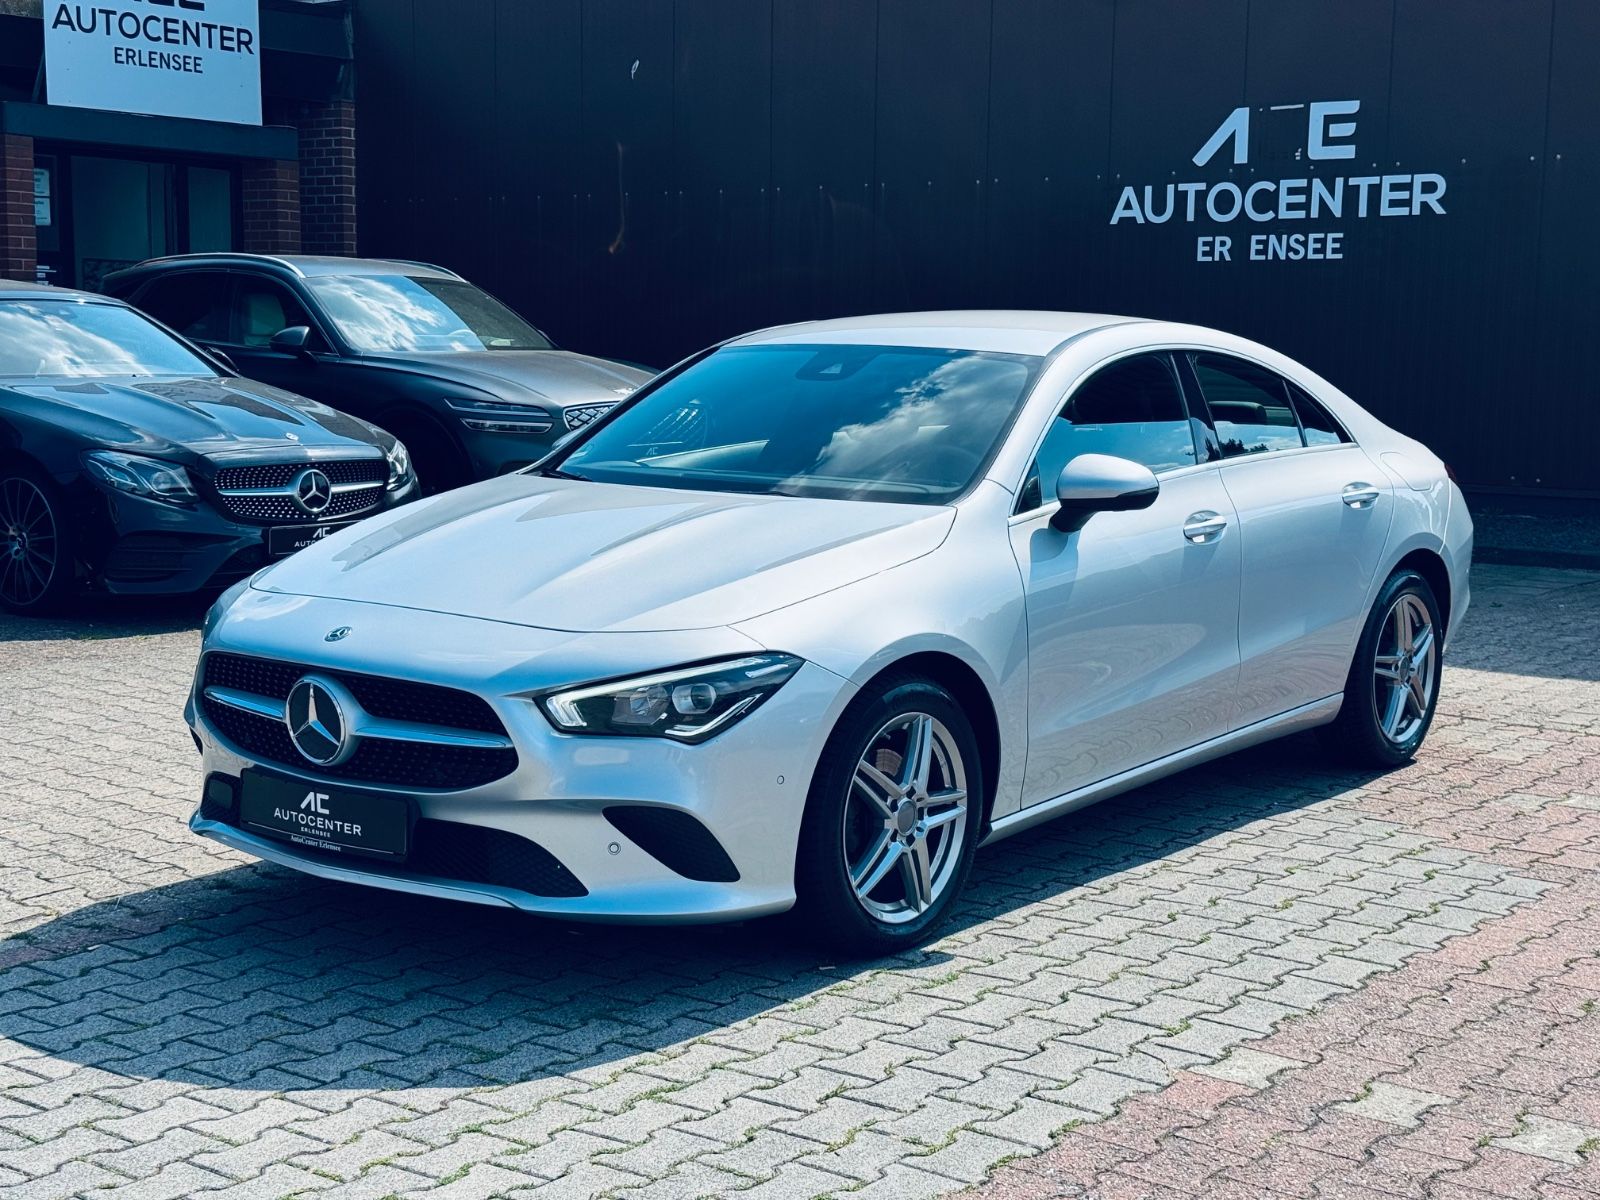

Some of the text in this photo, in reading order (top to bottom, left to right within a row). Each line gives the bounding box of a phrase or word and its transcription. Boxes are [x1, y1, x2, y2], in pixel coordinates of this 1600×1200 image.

[51, 3, 254, 55] AUTOCENTER
[114, 46, 204, 74] ERLENSEE
[1109, 173, 1447, 225] AUTOCENTER
[300, 791, 330, 815] AC
[273, 807, 362, 837] AUTOCENTER
[300, 826, 331, 838] ERLENSEE
